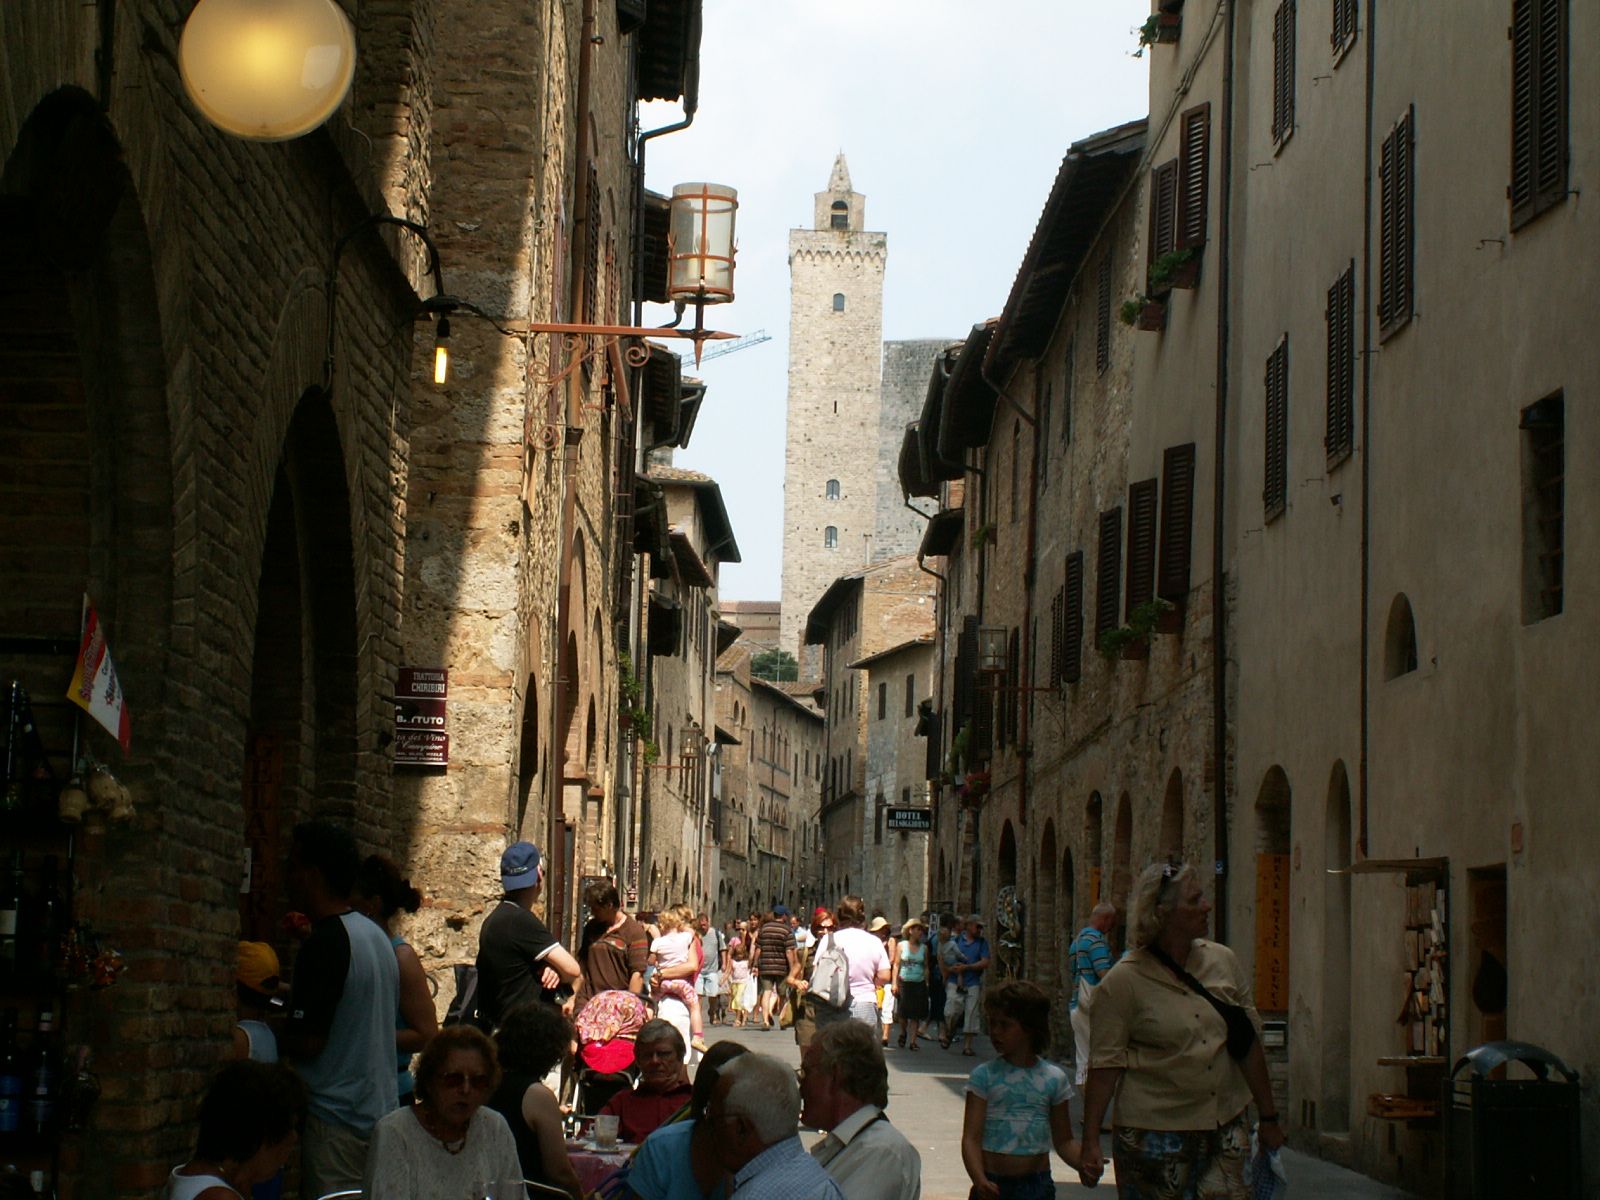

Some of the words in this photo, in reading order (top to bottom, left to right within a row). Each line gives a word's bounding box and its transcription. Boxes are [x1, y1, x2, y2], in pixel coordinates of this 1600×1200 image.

[413, 672, 444, 681] TRATTORIA
[411, 682, 445, 693] CHIRIBIRI
[396, 715, 444, 725] BTTUTO
[895, 811, 921, 820] HOTEL
